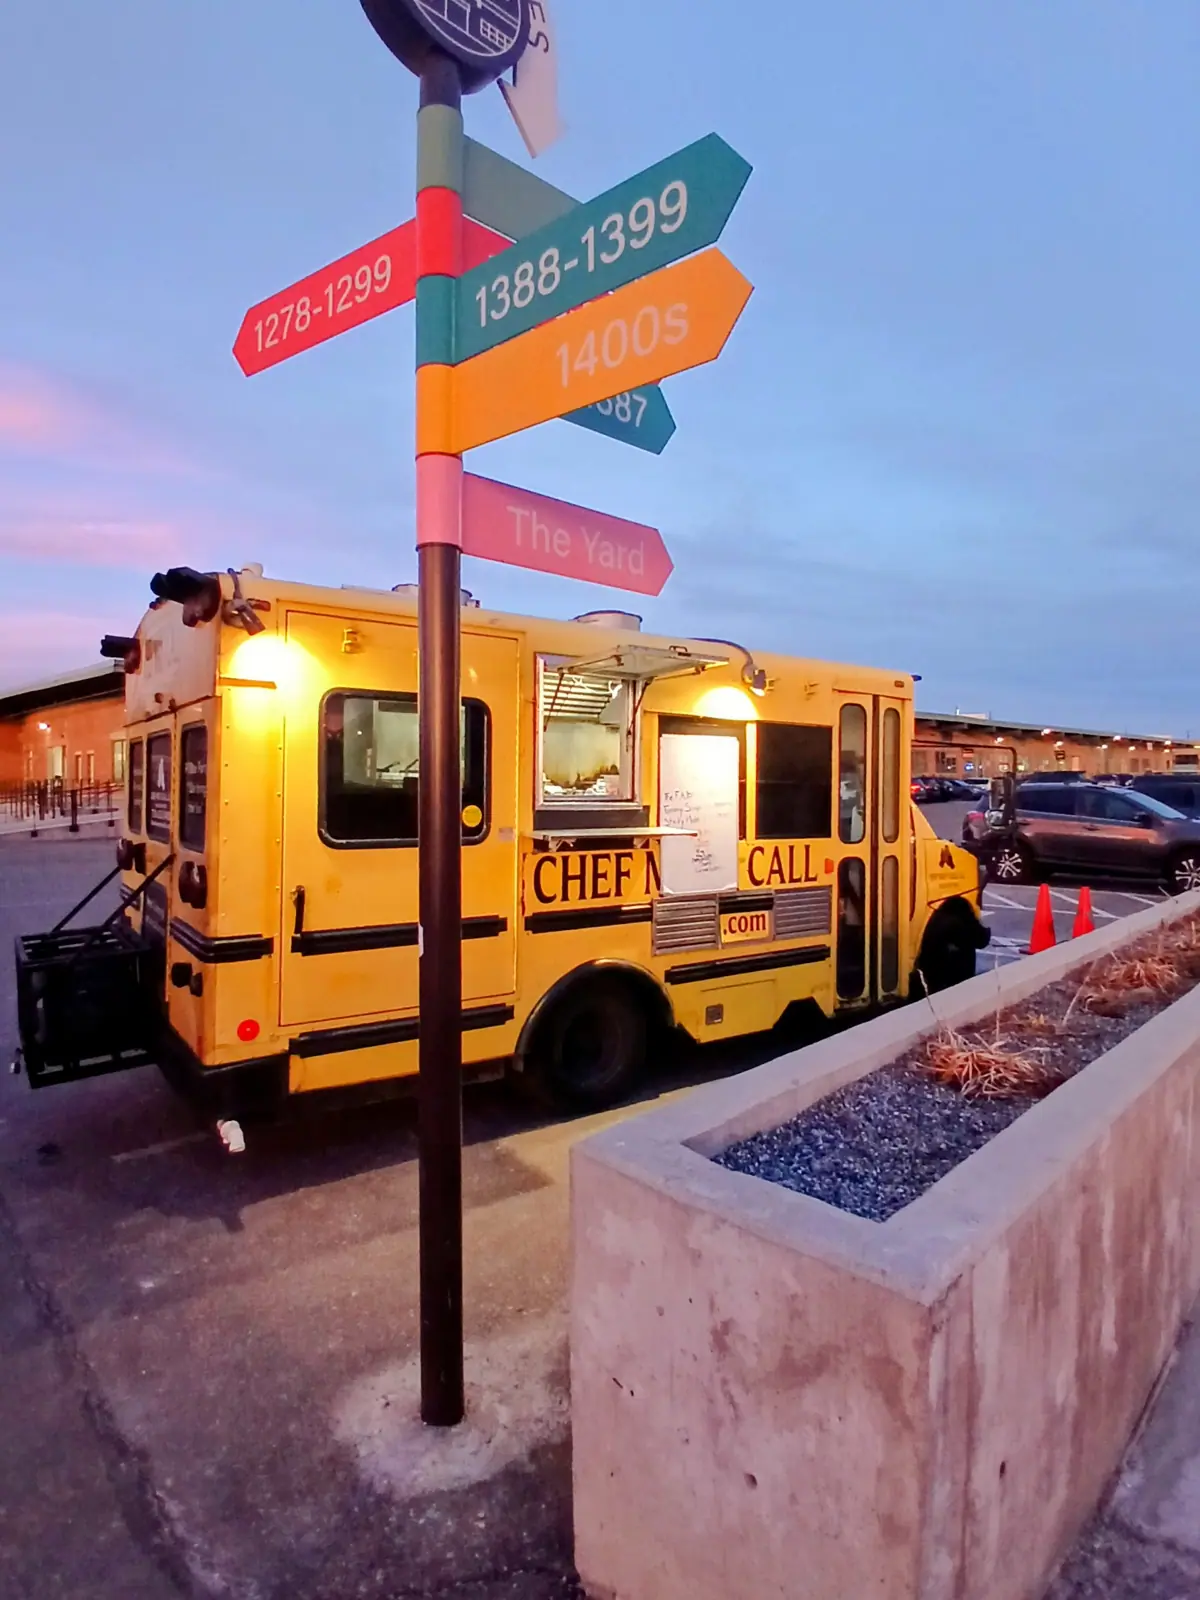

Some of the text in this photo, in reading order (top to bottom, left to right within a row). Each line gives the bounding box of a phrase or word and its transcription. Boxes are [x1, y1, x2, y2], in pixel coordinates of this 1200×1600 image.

[475, 180, 688, 328] 1388-1399
[254, 254, 392, 352] 1278-1299
[556, 302, 689, 388] 1400s
[506, 505, 644, 576] The Yard
[533, 851, 633, 904] CHEF
[747, 844, 818, 887] CALL
[723, 912, 767, 936] .com
